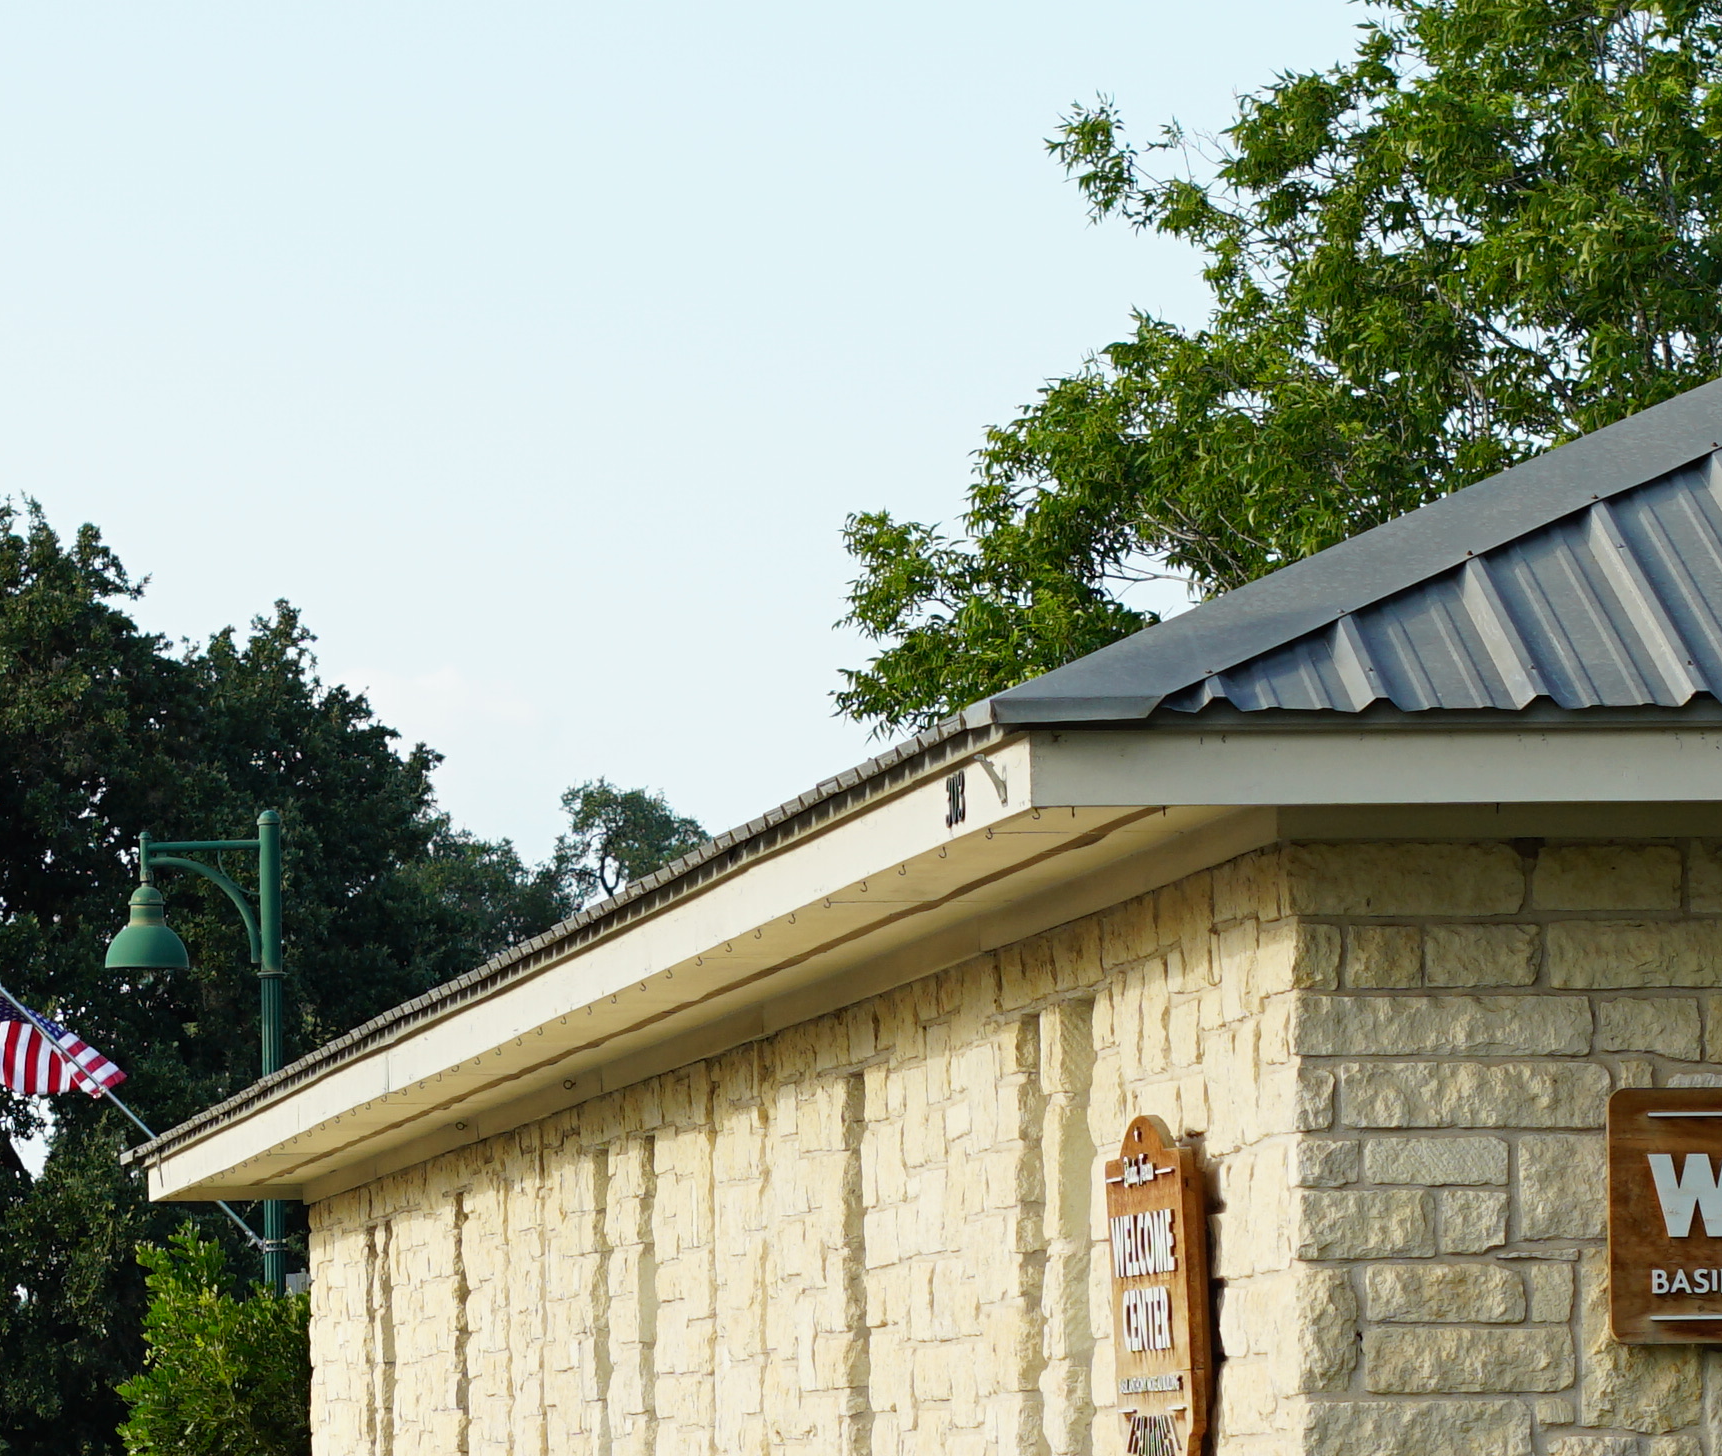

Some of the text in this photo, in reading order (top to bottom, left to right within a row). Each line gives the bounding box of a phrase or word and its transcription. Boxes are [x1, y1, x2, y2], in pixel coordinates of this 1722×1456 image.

[946, 769, 966, 829] 303
[1110, 1208, 1176, 1278] WELCOME
[1123, 1285, 1172, 1352] CENTER
